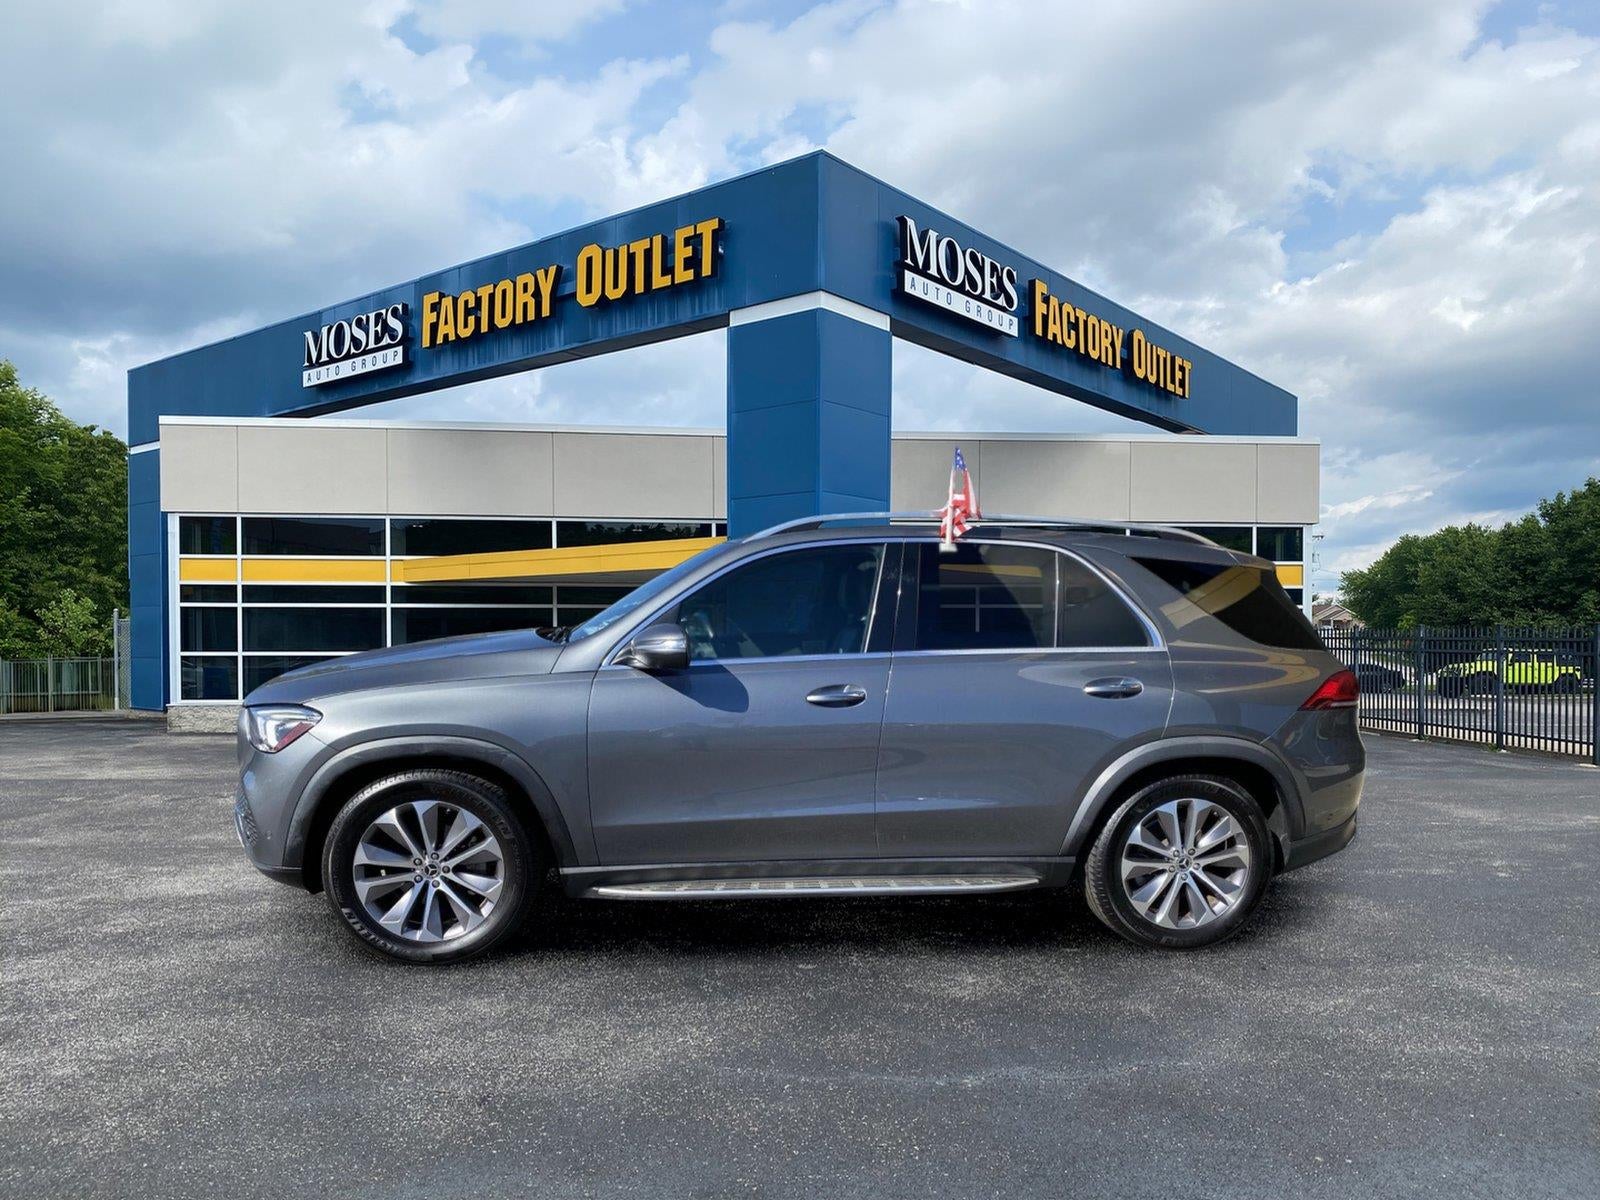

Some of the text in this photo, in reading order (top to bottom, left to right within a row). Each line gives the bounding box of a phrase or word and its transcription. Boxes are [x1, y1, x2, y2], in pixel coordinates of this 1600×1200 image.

[422, 218, 719, 348] FACTORY OUTLET
[904, 215, 1018, 311] MOSES
[303, 304, 403, 366] MOSES
[909, 277, 1015, 331] AUTO GROUP
[1035, 280, 1192, 398] FACTORY OUTLET
[307, 350, 398, 383] AUTO GROUP
